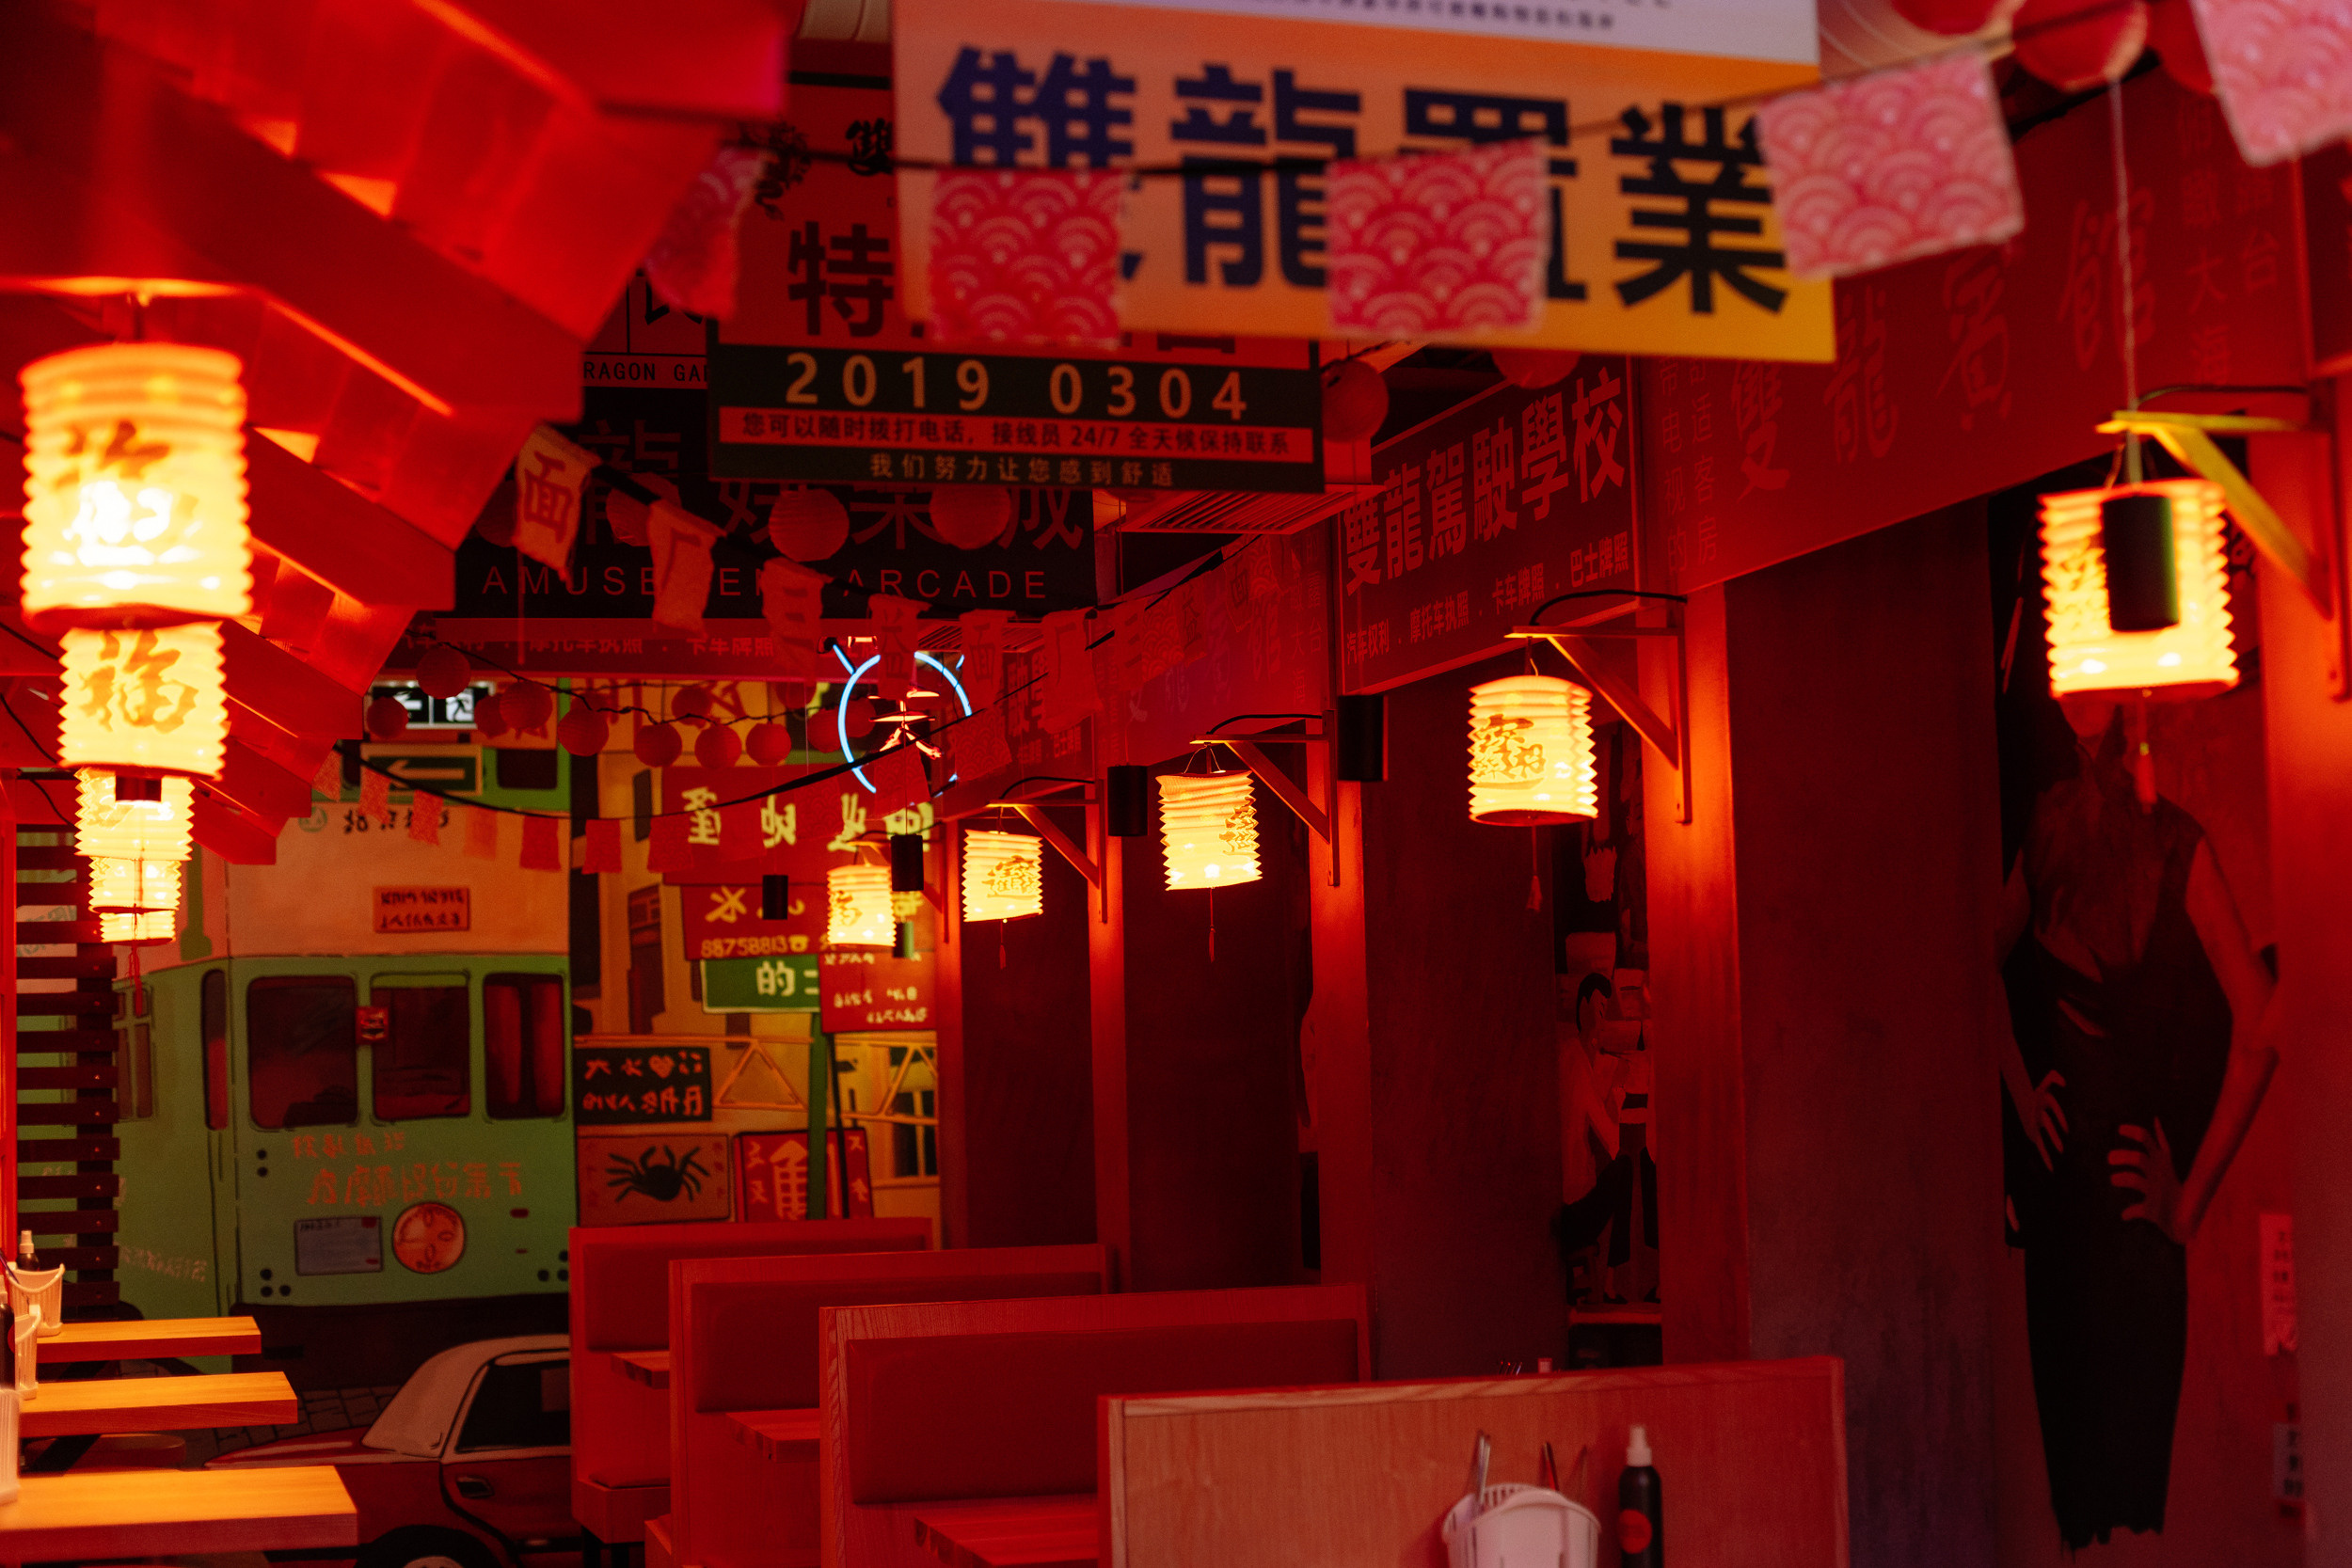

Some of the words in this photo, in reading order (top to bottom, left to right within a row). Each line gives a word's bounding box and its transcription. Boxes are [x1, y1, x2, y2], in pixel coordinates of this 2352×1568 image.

[583, 361, 656, 382] RAGON
[785, 354, 990, 410] 2019
[1049, 364, 1248, 420] 0304
[1070, 425, 1120, 451] 24/7
[870, 451, 1173, 488] 我们努力让您感到舒适
[482, 566, 762, 596] AMUSEE
